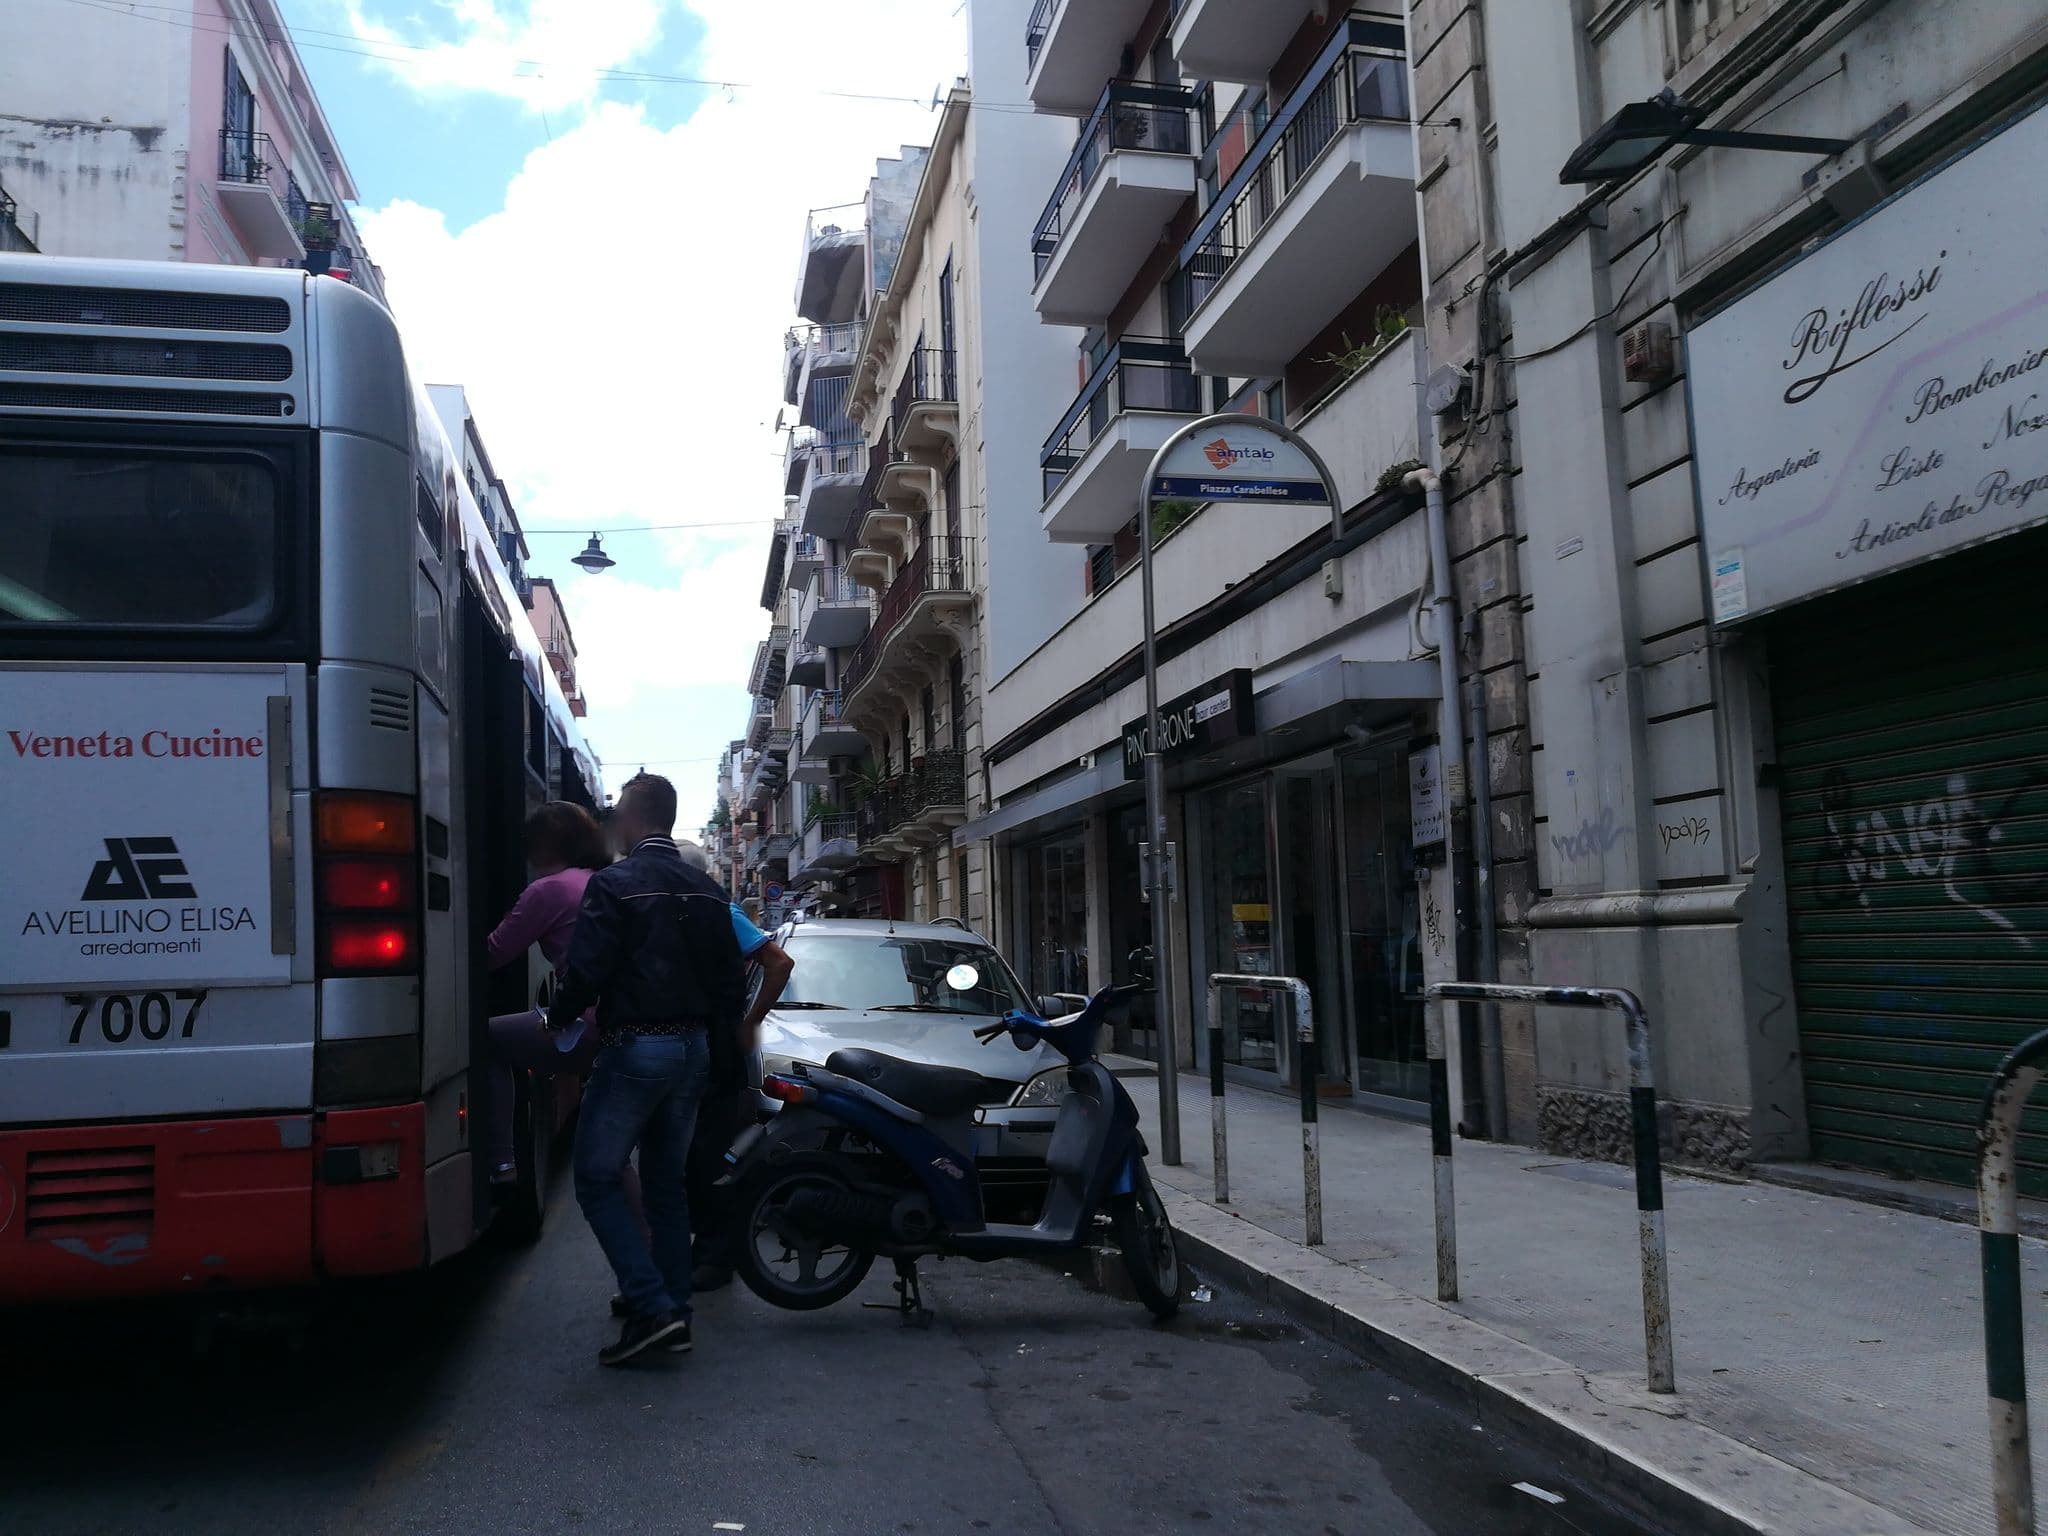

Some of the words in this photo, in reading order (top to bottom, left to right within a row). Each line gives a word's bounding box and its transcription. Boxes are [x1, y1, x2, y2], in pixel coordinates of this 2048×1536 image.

[1783, 249, 1947, 404] Riflessi
[1216, 447, 1275, 459] amtab
[1874, 446, 1945, 491] Liste
[1199, 483, 1232, 493] Piazza
[1232, 485, 1289, 496] Carabellese
[1718, 447, 1821, 505] Argenteria
[1835, 500, 1937, 560] Articoli
[1938, 494, 1967, 525] da
[7, 730, 133, 758] Veneta
[141, 728, 264, 758] Cucine
[22, 908, 171, 936] AVELLINO
[181, 906, 257, 932] ELISA
[80, 938, 201, 957] arredamenti
[64, 988, 208, 1044] 7007
